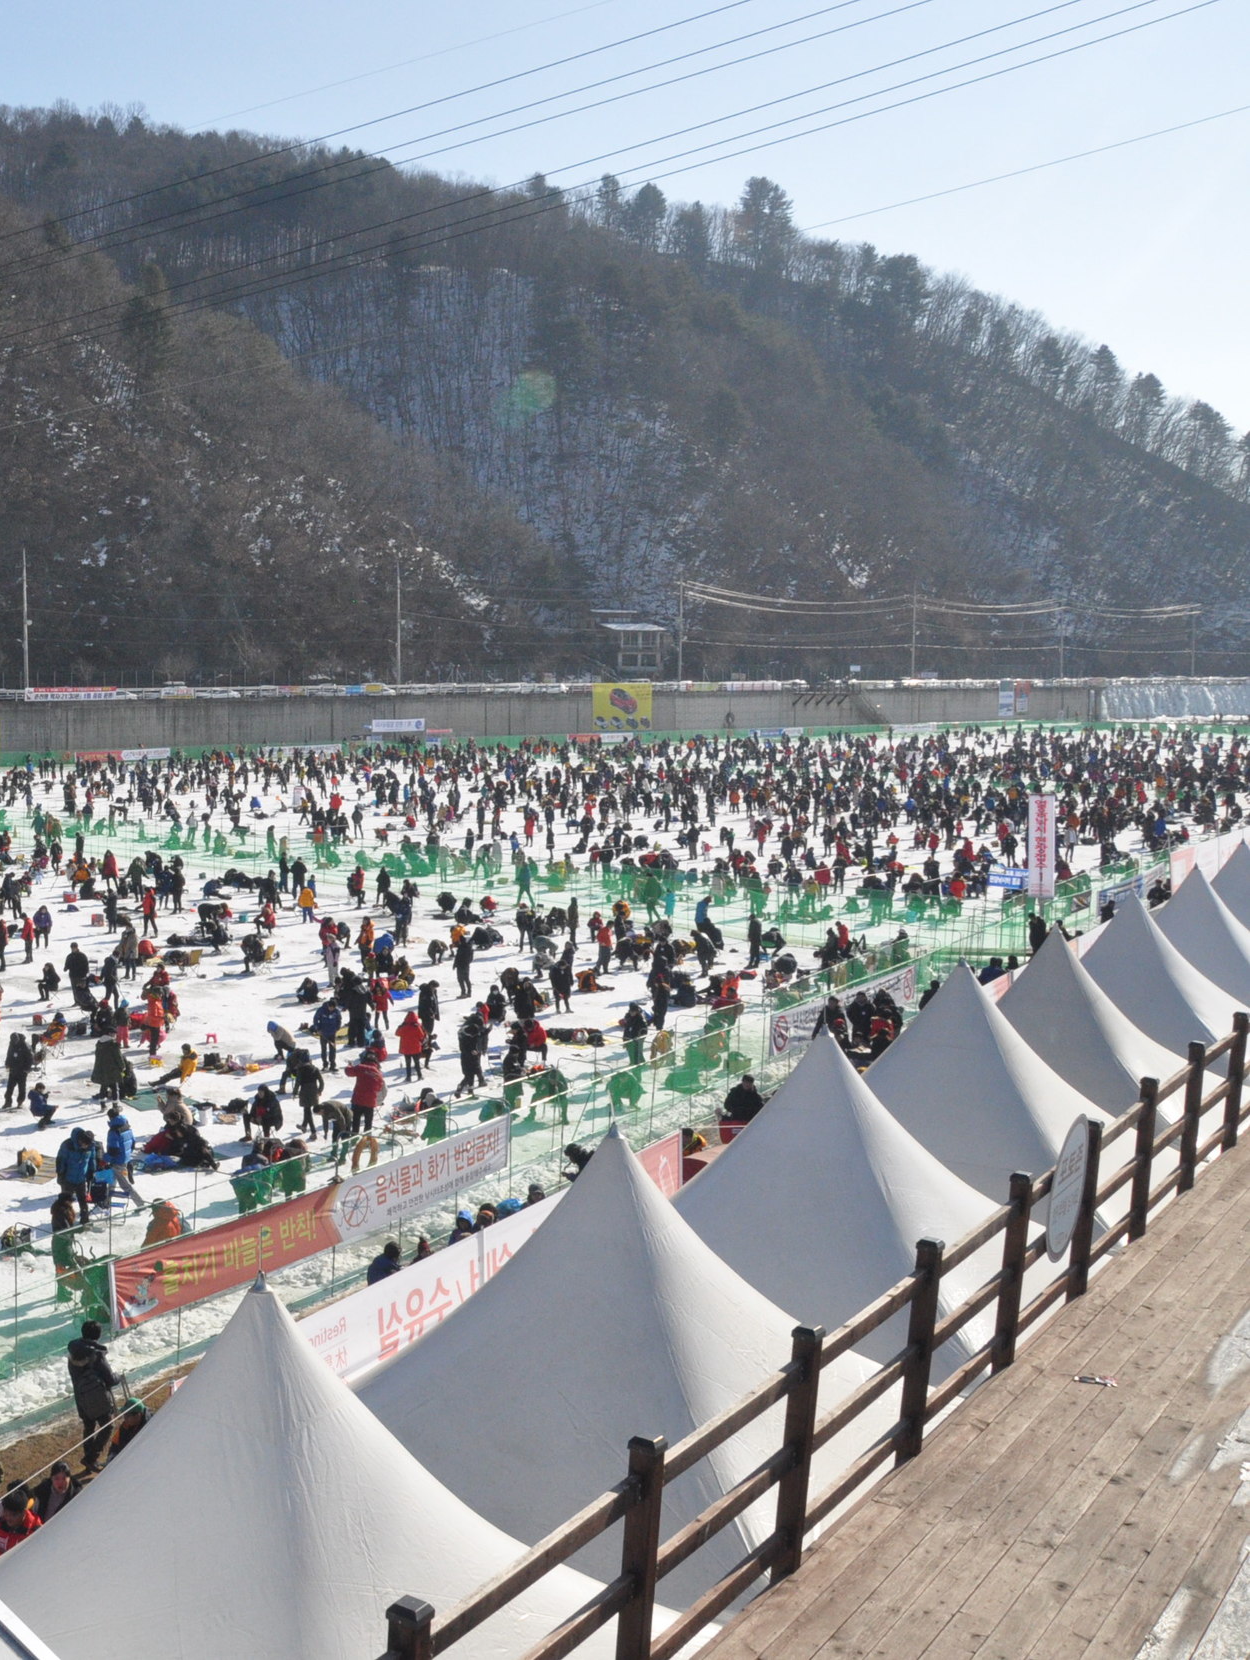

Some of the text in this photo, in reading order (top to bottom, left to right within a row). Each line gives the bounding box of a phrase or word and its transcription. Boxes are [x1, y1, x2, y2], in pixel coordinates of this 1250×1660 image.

[375, 1127, 500, 1206] 음식물과 화기 반입금지!
[223, 1227, 275, 1270] 바늘은
[279, 1208, 317, 1252] 반칙!
